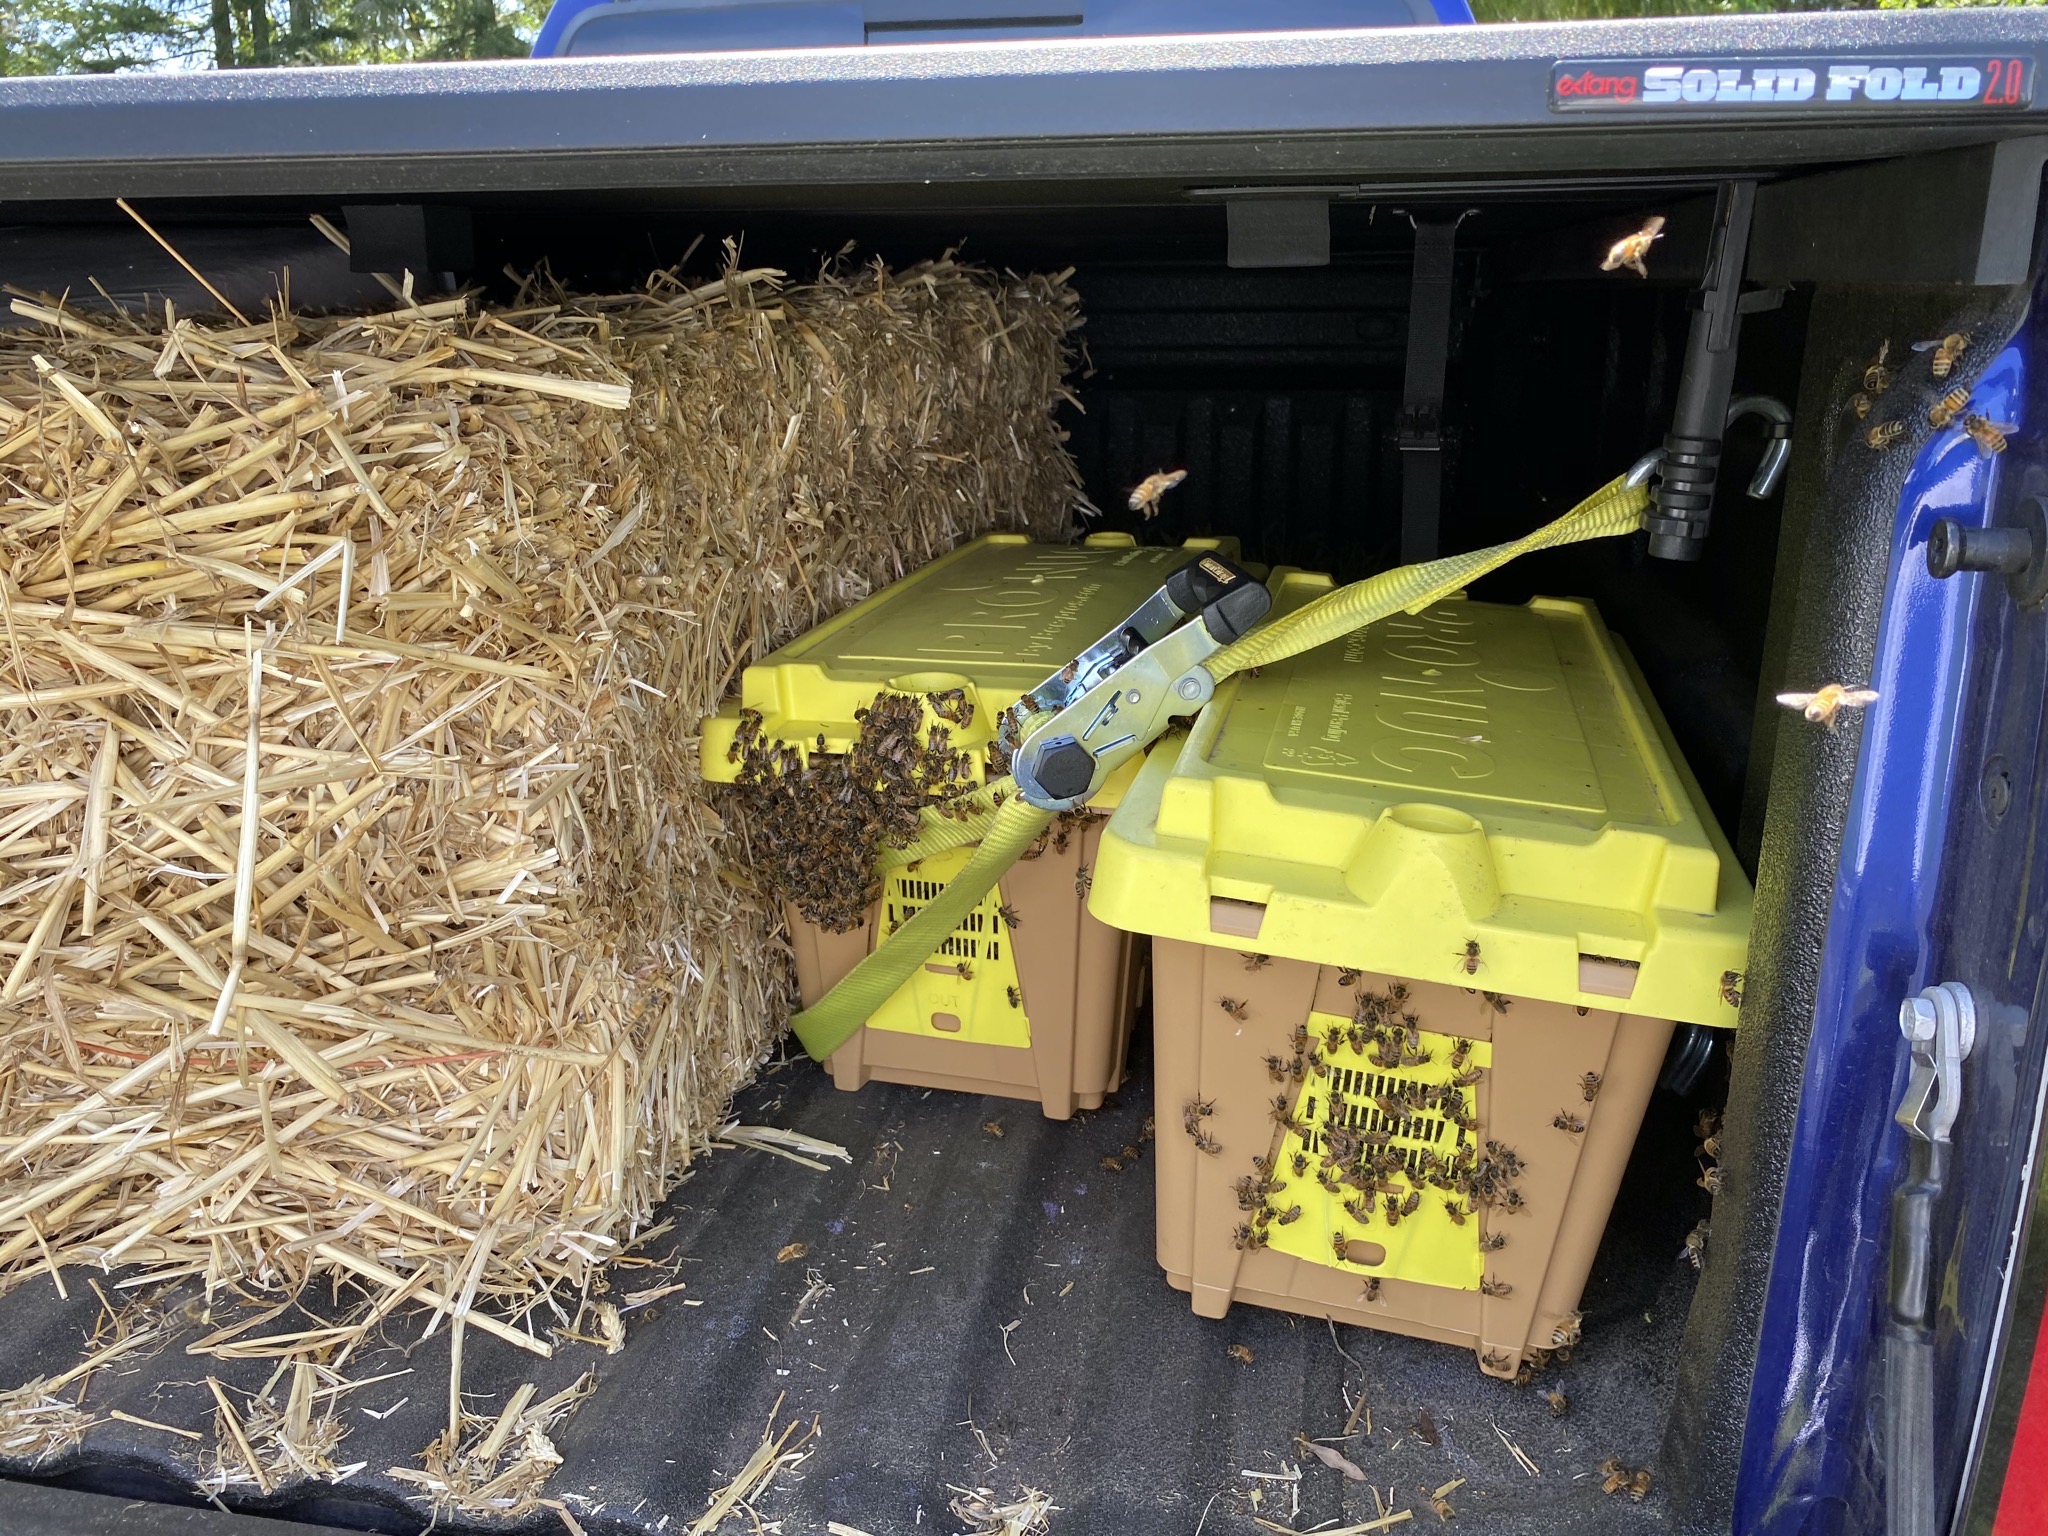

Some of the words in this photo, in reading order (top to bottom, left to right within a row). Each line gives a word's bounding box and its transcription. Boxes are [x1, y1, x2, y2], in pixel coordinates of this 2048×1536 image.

[1556, 71, 1637, 104] extang
[1643, 66, 1816, 102] SOLID
[1826, 65, 1981, 100] FOLD
[1983, 59, 2022, 104] 2.0
[928, 992, 960, 1009] OUT
